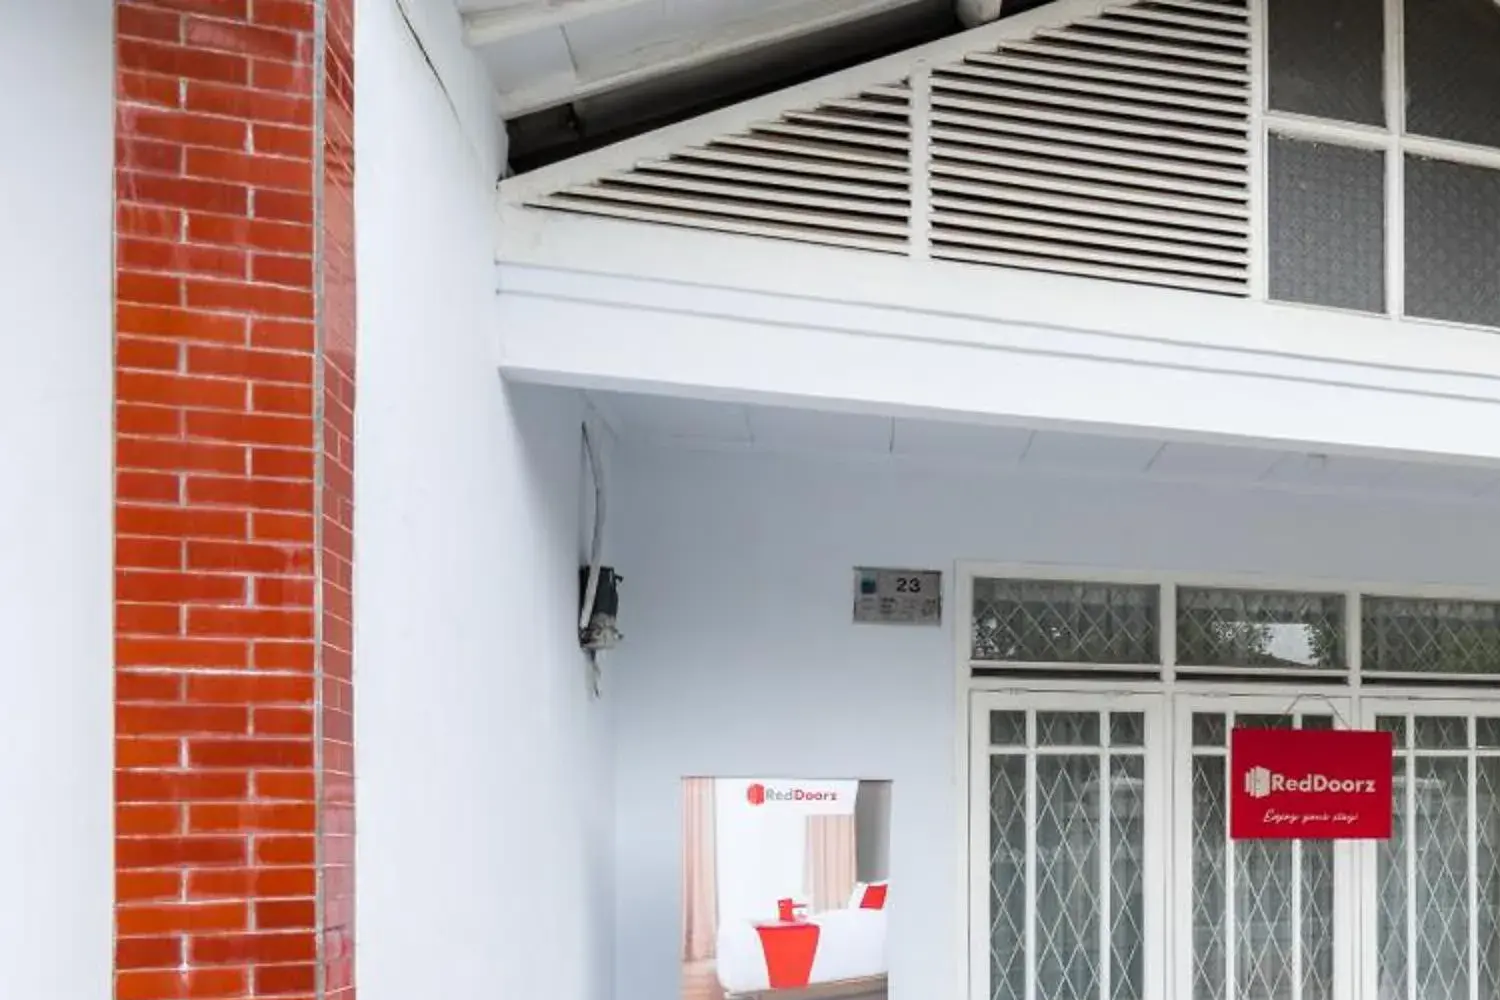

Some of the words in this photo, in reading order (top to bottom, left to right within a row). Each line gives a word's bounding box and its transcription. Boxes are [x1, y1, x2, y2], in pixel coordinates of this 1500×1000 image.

[896, 577, 921, 594] 23
[1271, 773, 1377, 793] RedDoorz
[765, 787, 837, 801] RedDoorz
[1263, 808, 1299, 825] Enjoy
